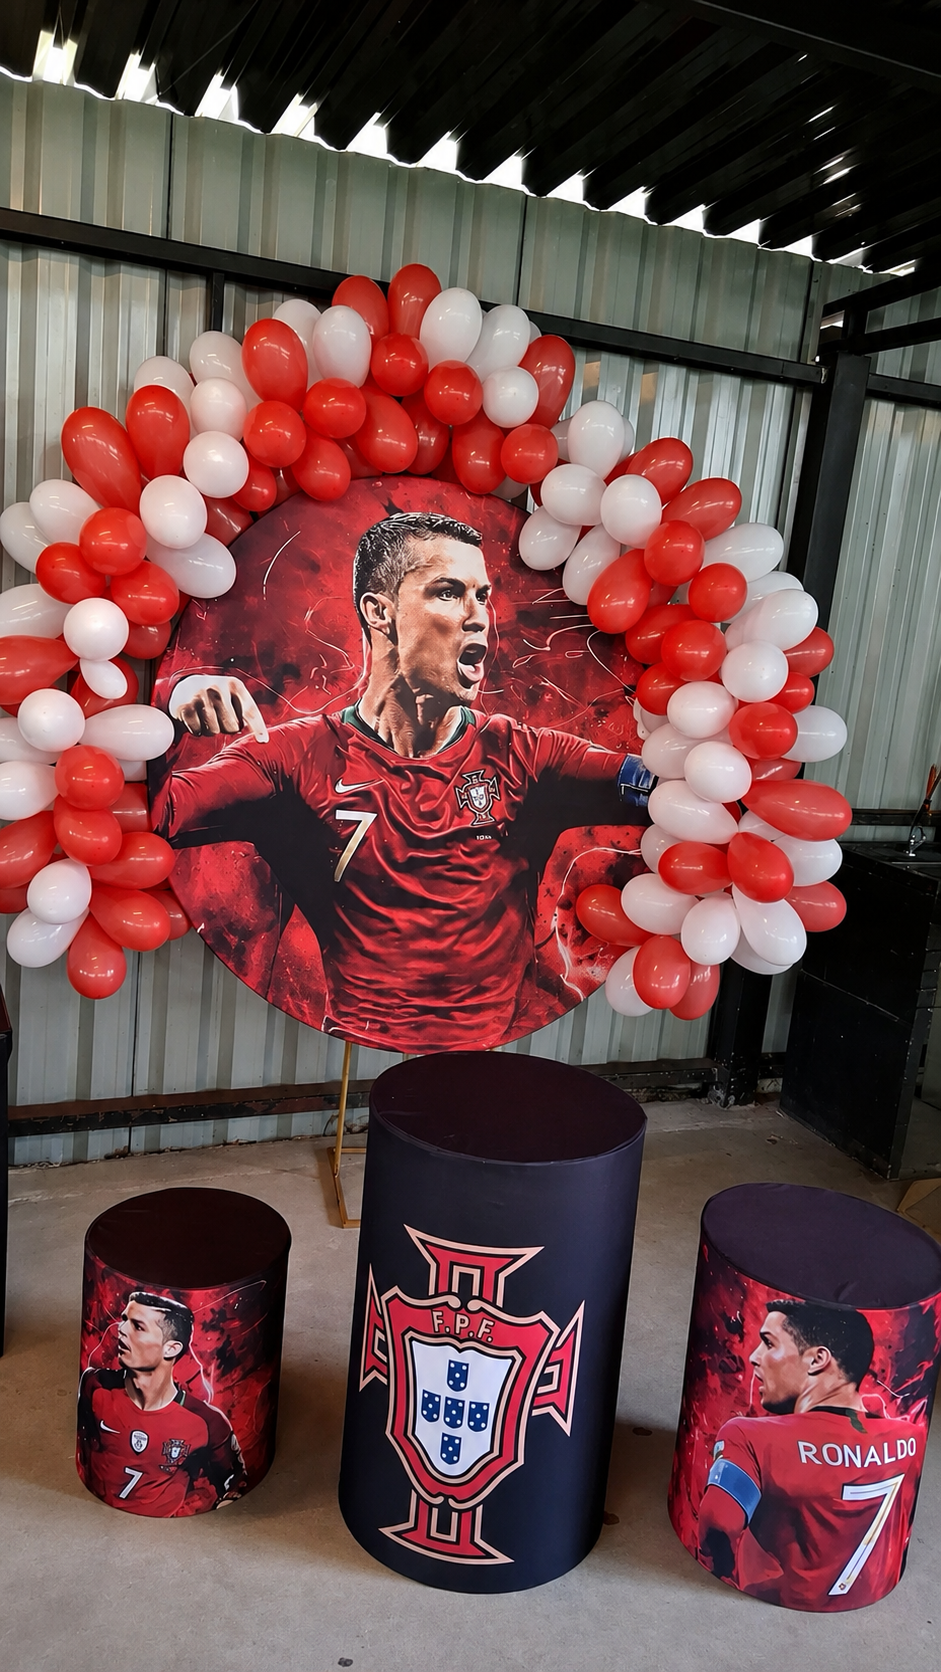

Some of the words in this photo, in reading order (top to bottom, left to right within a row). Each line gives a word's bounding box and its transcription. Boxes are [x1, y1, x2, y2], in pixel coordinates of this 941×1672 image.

[334, 809, 378, 882] 7
[431, 1310, 494, 1343] F.P.F.
[797, 1437, 917, 1468] RONALDO
[118, 1466, 144, 1499] 7
[827, 1473, 905, 1596] 7
